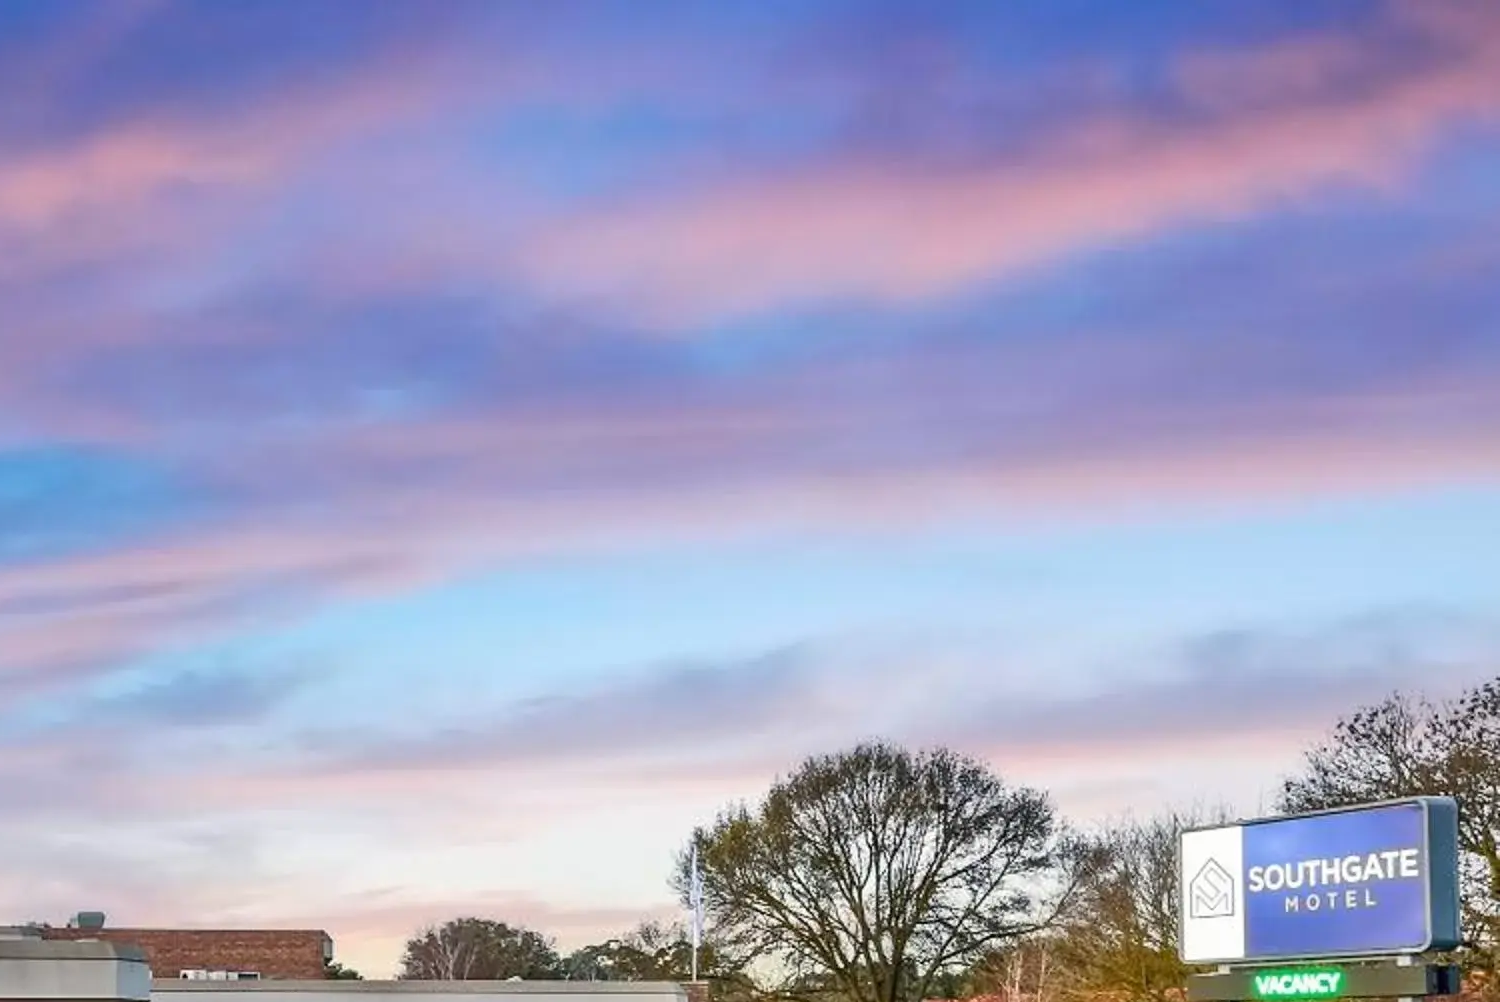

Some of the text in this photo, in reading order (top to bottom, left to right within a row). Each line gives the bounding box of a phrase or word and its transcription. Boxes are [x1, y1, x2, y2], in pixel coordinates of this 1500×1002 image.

[1249, 849, 1419, 893] SOUTHGATE
[1285, 888, 1377, 913] MOTEL
[1255, 972, 1341, 995] VACANCY
